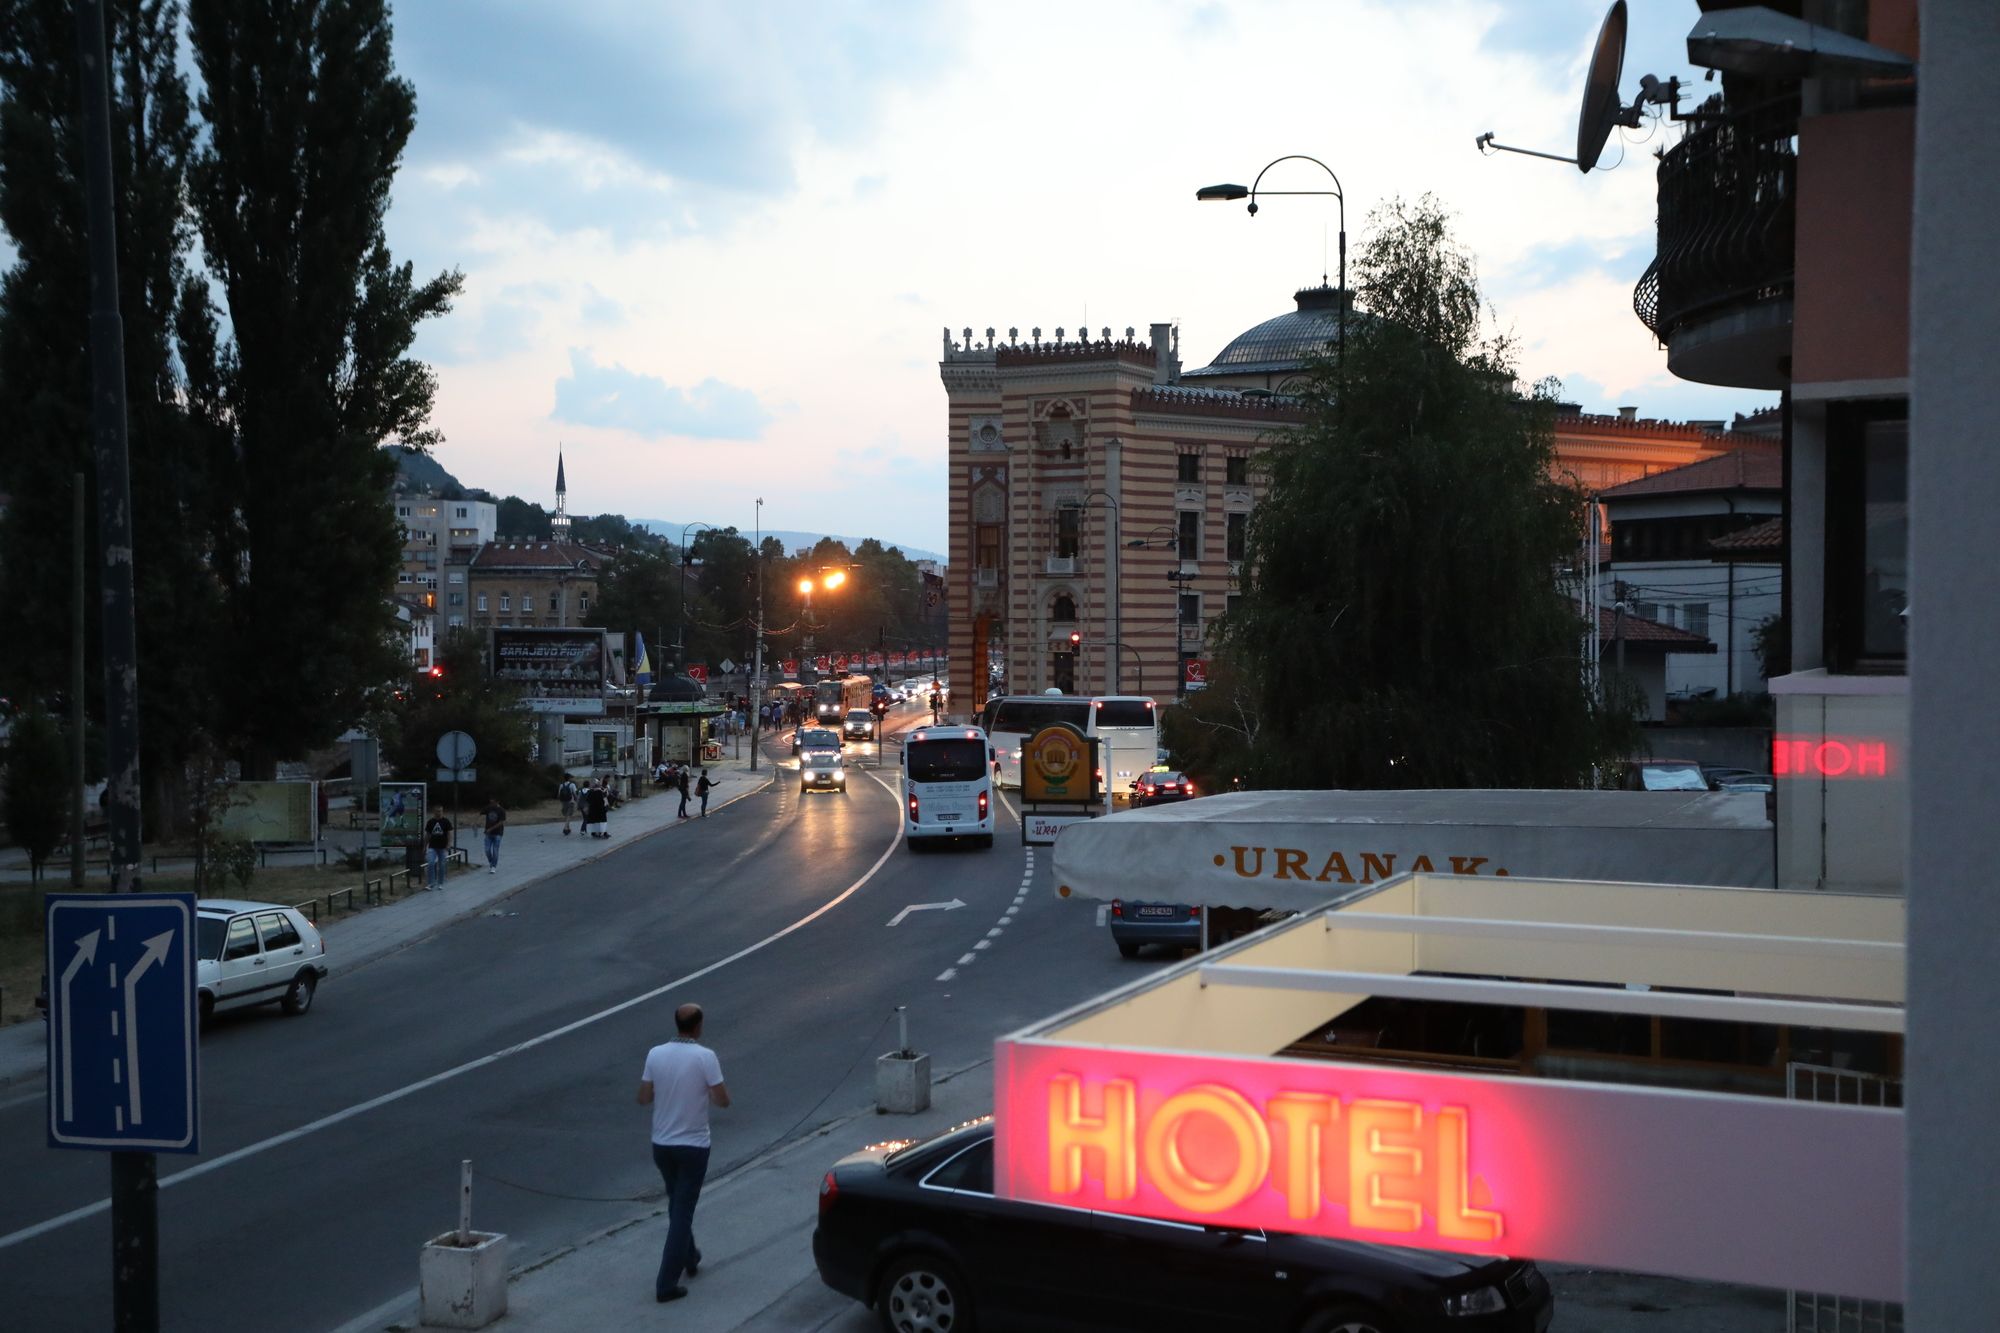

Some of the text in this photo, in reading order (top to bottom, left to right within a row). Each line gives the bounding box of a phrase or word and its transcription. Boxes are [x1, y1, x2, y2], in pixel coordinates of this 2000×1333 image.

[500, 647, 592, 656] SARAJEVO FIGHT
[1046, 1071, 1506, 1242] HOTEL
